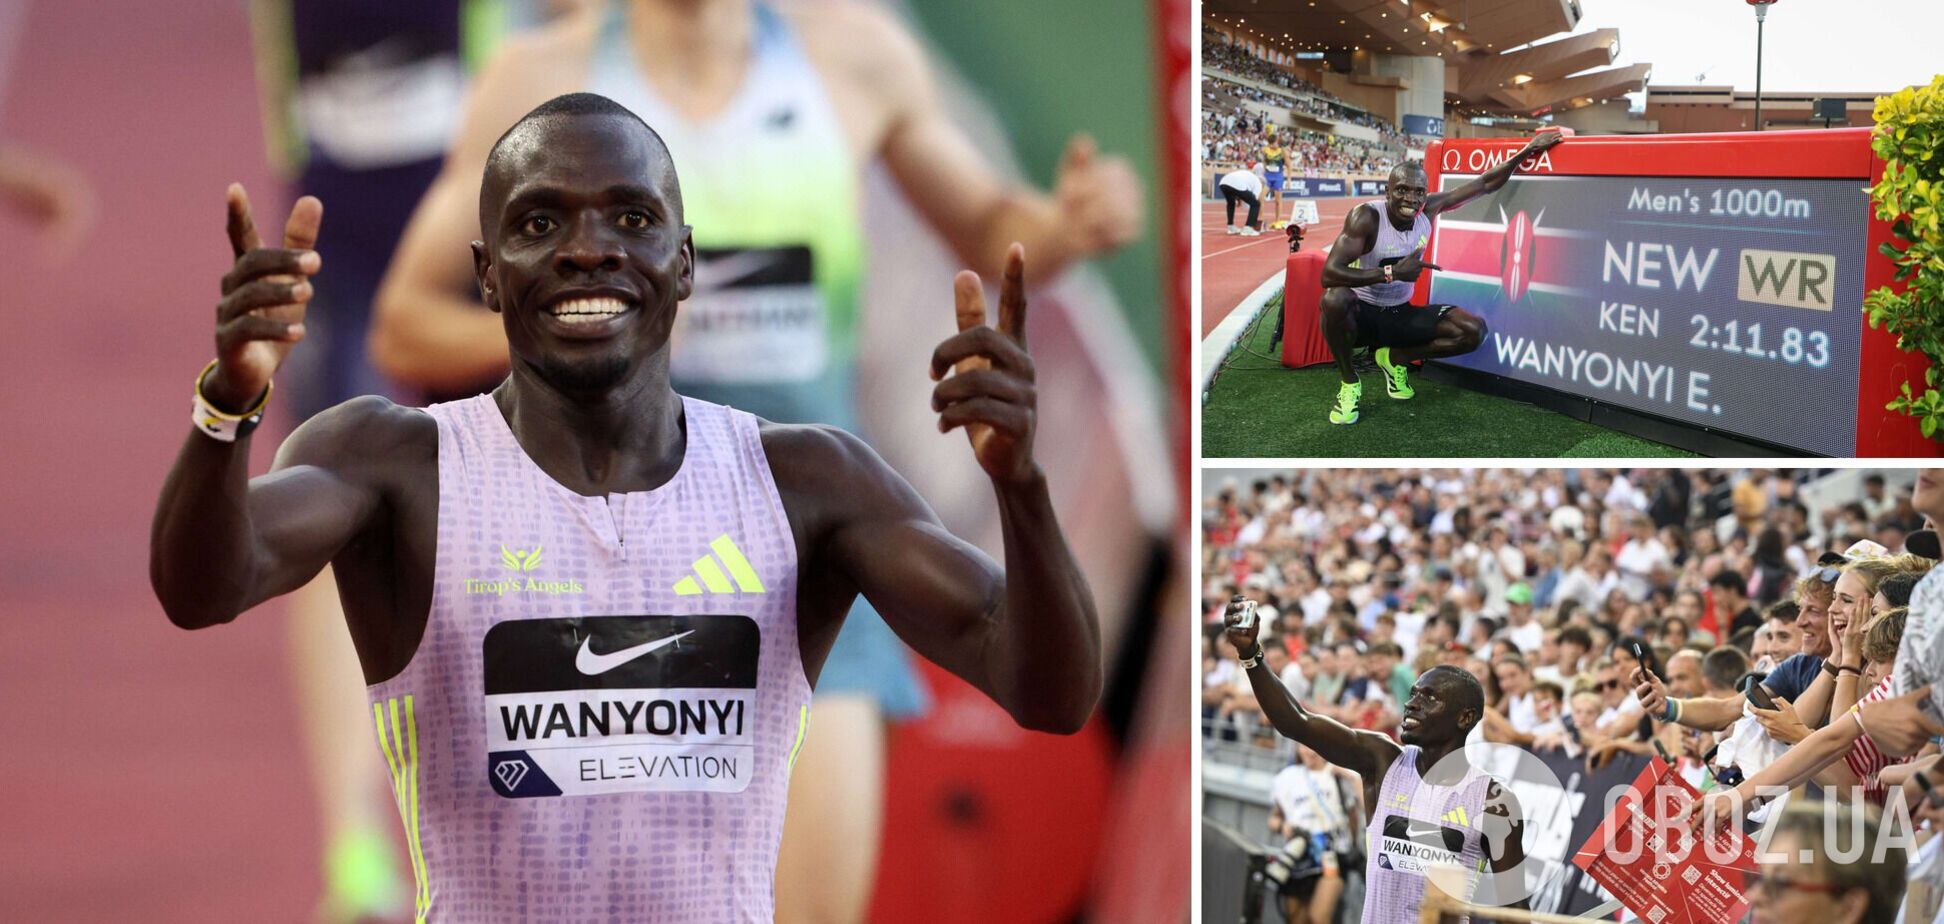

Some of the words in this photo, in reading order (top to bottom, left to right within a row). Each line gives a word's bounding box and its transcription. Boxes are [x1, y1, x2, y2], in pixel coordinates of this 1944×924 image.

[1298, 209, 1305, 219] 2
[1627, 186, 1700, 213] Men's
[1710, 189, 1811, 218] 1000m
[1603, 240, 1719, 292] NEW
[1744, 255, 1828, 304] WR
[1599, 301, 1660, 338] KEN
[1690, 314, 1830, 368] 2:11.83
[1495, 333, 1674, 403] WANYONYI
[1688, 371, 1722, 415] E.
[464, 577, 521, 596] Tirop's
[523, 578, 584, 595] Angels
[500, 700, 744, 741] WANYONYI
[579, 756, 737, 782] ELEVATION
[1709, 869, 1726, 884] Show
